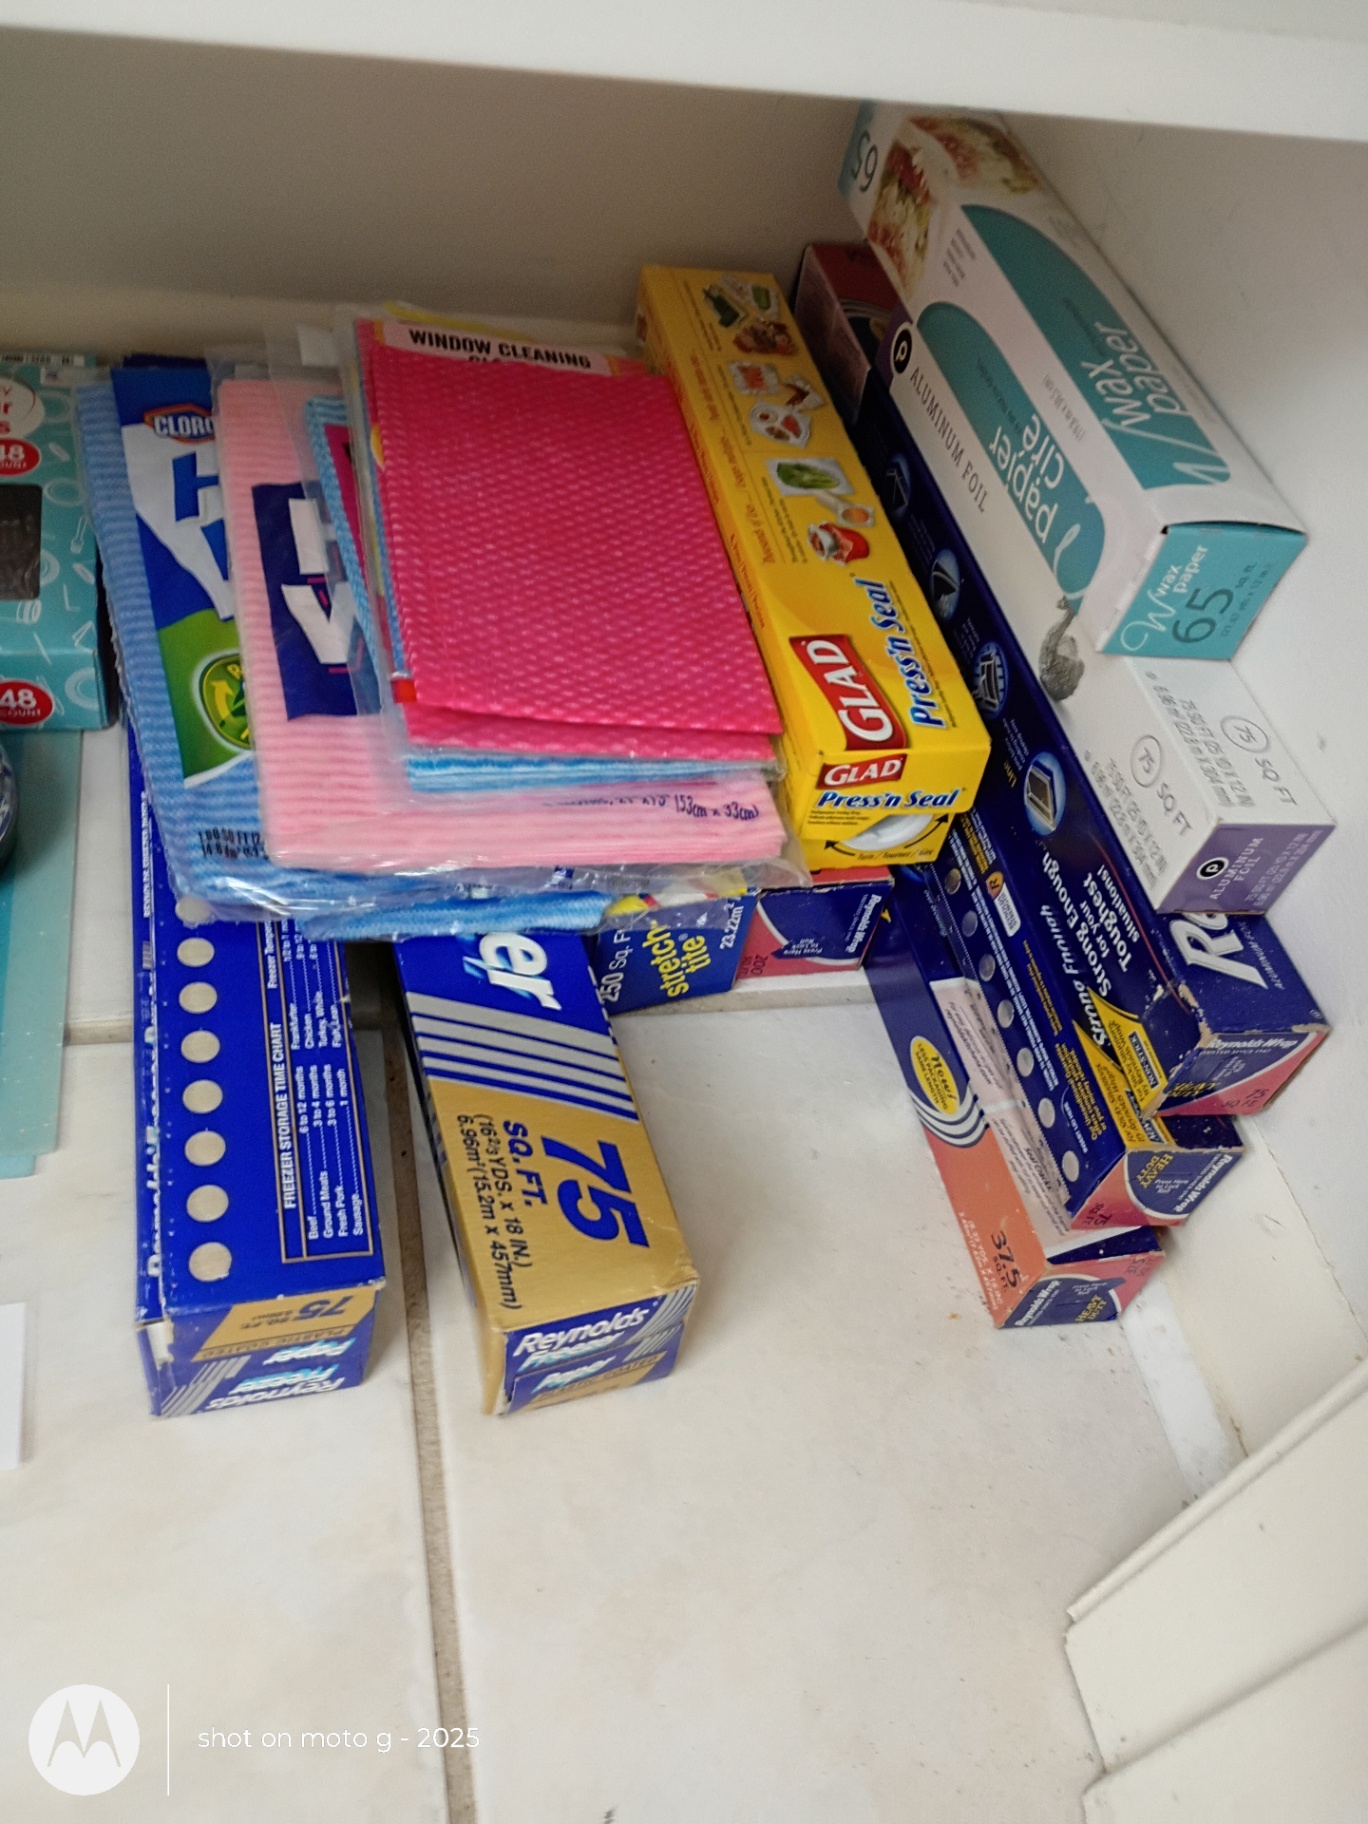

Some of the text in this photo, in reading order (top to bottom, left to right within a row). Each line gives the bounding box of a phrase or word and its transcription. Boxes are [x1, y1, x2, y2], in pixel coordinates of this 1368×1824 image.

[408, 329, 591, 369] WINDOW CLEANING
[1094, 322, 1188, 417] paper
[1081, 359, 1150, 426] wax
[910, 367, 967, 468] ALUMINUM
[962, 461, 988, 513] FOIL
[990, 426, 1058, 545] papier
[1154, 565, 1182, 597] wax
[1173, 545, 1208, 594] paper
[855, 576, 904, 632] Seal
[1172, 588, 1234, 644] 65
[806, 639, 894, 742] GLAD
[885, 632, 948, 729] Press'n
[824, 758, 901, 787] GLAD
[1256, 757, 1279, 783] SQ
[1274, 786, 1298, 806] FT
[674, 794, 708, 818] (53cm
[723, 803, 759, 821] 33cm)
[816, 788, 962, 809] Press'n Seal
[1157, 781, 1176, 815] SQ
[1173, 810, 1192, 836] FT
[1036, 848, 1085, 928] Enough
[1208, 833, 1264, 901] ALUMINUM
[1232, 852, 1261, 885] FOIL
[856, 894, 882, 934] Reynolds
[1077, 898, 1112, 958] for your
[1080, 869, 1137, 972] Toughest
[1097, 864, 1140, 943] situations!
[685, 935, 711, 979] tite
[845, 930, 866, 954] Wrap
[1070, 920, 1117, 997] Strong
[265, 954, 278, 988] Freezer
[600, 944, 629, 1003] 250 Sq.
[287, 1002, 300, 1050] Frankfurter
[302, 1013, 314, 1049] Chicken
[1263, 1039, 1299, 1050] Wrap
[337, 1068, 348, 1097] month
[913, 1050, 940, 1104] SAME LENGTH
[917, 1042, 949, 1110] LESS PACKAGING
[1105, 1021, 1145, 1101] For Sticky Situations
[1124, 1046, 1150, 1095] try Reynolds
[1129, 1033, 1157, 1086] NON-STICK
[269, 1022, 296, 1209] FREEZER STORAGE TIME CHART
[1053, 1042, 1099, 1141] Our Unconditional Guarantee
[1062, 1100, 1074, 1119] HERE
[1075, 1080, 1094, 1113] complete
[295, 1065, 319, 1240] Beef 6 to 12 months
[309, 1064, 334, 1238] Ground Meats 3 to 4 months
[323, 1063, 348, 1237] Fresh Pork 3 to 6 months
[502, 1115, 547, 1209] SQ. FT.
[1023, 1146, 1038, 1165] Seal
[1142, 1153, 1174, 1188] HEAVY
[497, 1199, 517, 1213] x
[541, 1135, 650, 1248] 75
[1175, 1153, 1233, 1213] Reynolds Wrap
[351, 1192, 363, 1235] Sausage
[501, 1214, 524, 1237] 18
[490, 1242, 521, 1311] 457mm)
[506, 1235, 533, 1271] IN.)
[990, 1229, 1022, 1288] 37.5
[296, 1295, 353, 1321] 75
[1014, 1276, 1061, 1329] Reynolds Wrap
[1075, 1295, 1103, 1323] HEAVY
[262, 1337, 356, 1366] Paper
[512, 1307, 650, 1357] Reynolds
[205, 1376, 345, 1411] Reynolds
[530, 1355, 617, 1395] Paper
